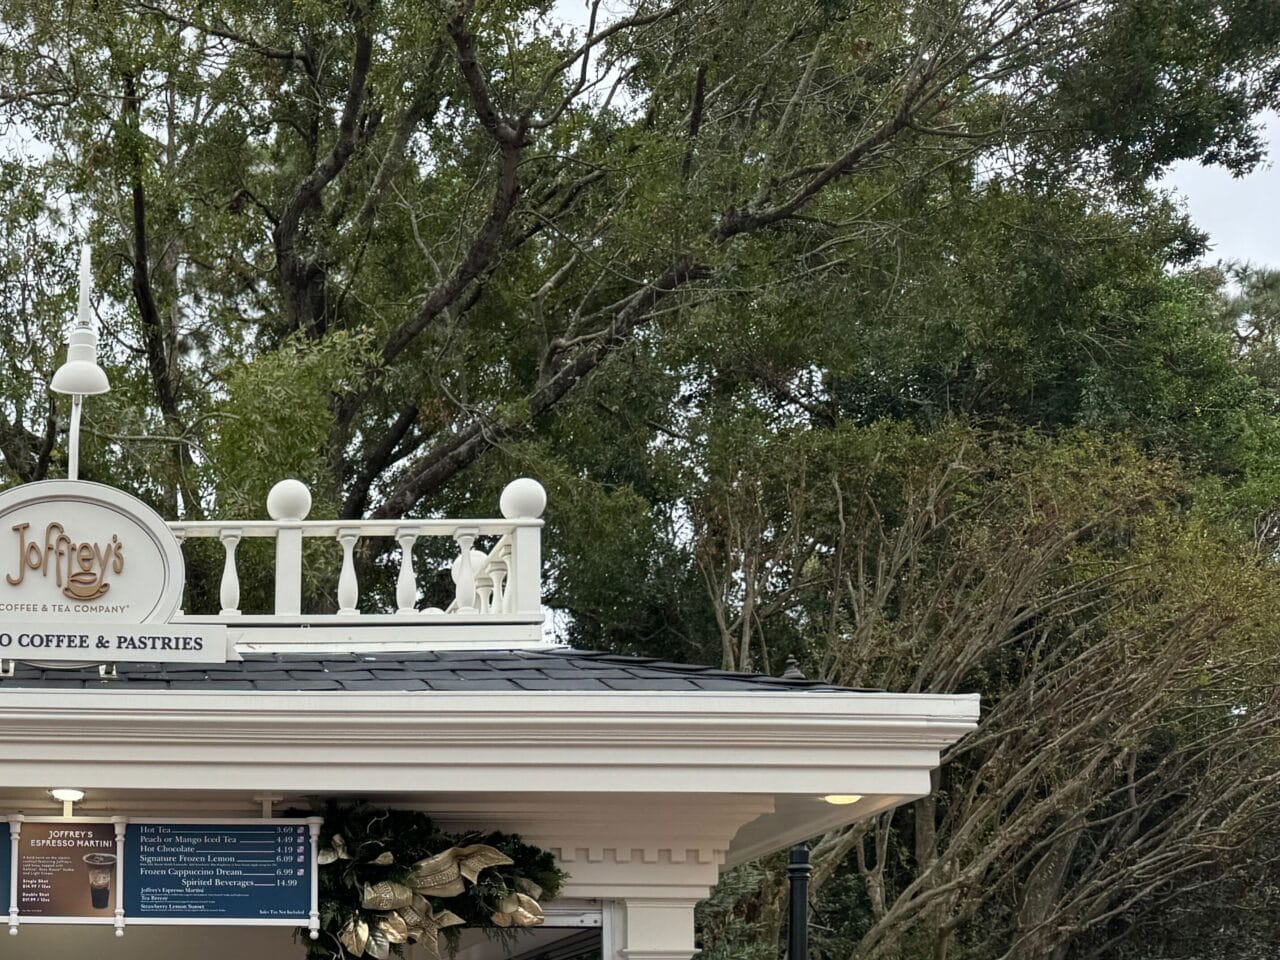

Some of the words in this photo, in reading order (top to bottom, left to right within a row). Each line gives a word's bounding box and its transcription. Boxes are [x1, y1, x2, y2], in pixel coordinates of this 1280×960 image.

[6, 522, 124, 587] Joffrey's
[0, 603, 39, 612] COFFEE
[41, 604, 49, 612] &
[52, 605, 71, 613] TEA
[74, 605, 126, 613] COMPANY
[18, 633, 89, 648] COFFEE
[95, 635, 110, 649] &
[116, 635, 203, 651] PASTRIES
[48, 830, 93, 839] JOFFREY'S
[76, 840, 112, 848] MARTINI
[175, 836, 202, 845] Mango
[276, 836, 293, 844] 4.49
[157, 845, 195, 853] Chocolate
[139, 855, 177, 864] Signature
[208, 855, 235, 863] Lemon
[276, 855, 293, 863] 6.09
[140, 868, 166, 876] Frozen
[168, 868, 214, 877] Cappuccino
[216, 868, 242, 876] Dream
[181, 879, 212, 888] Spirited
[215, 879, 254, 888] Beverages
